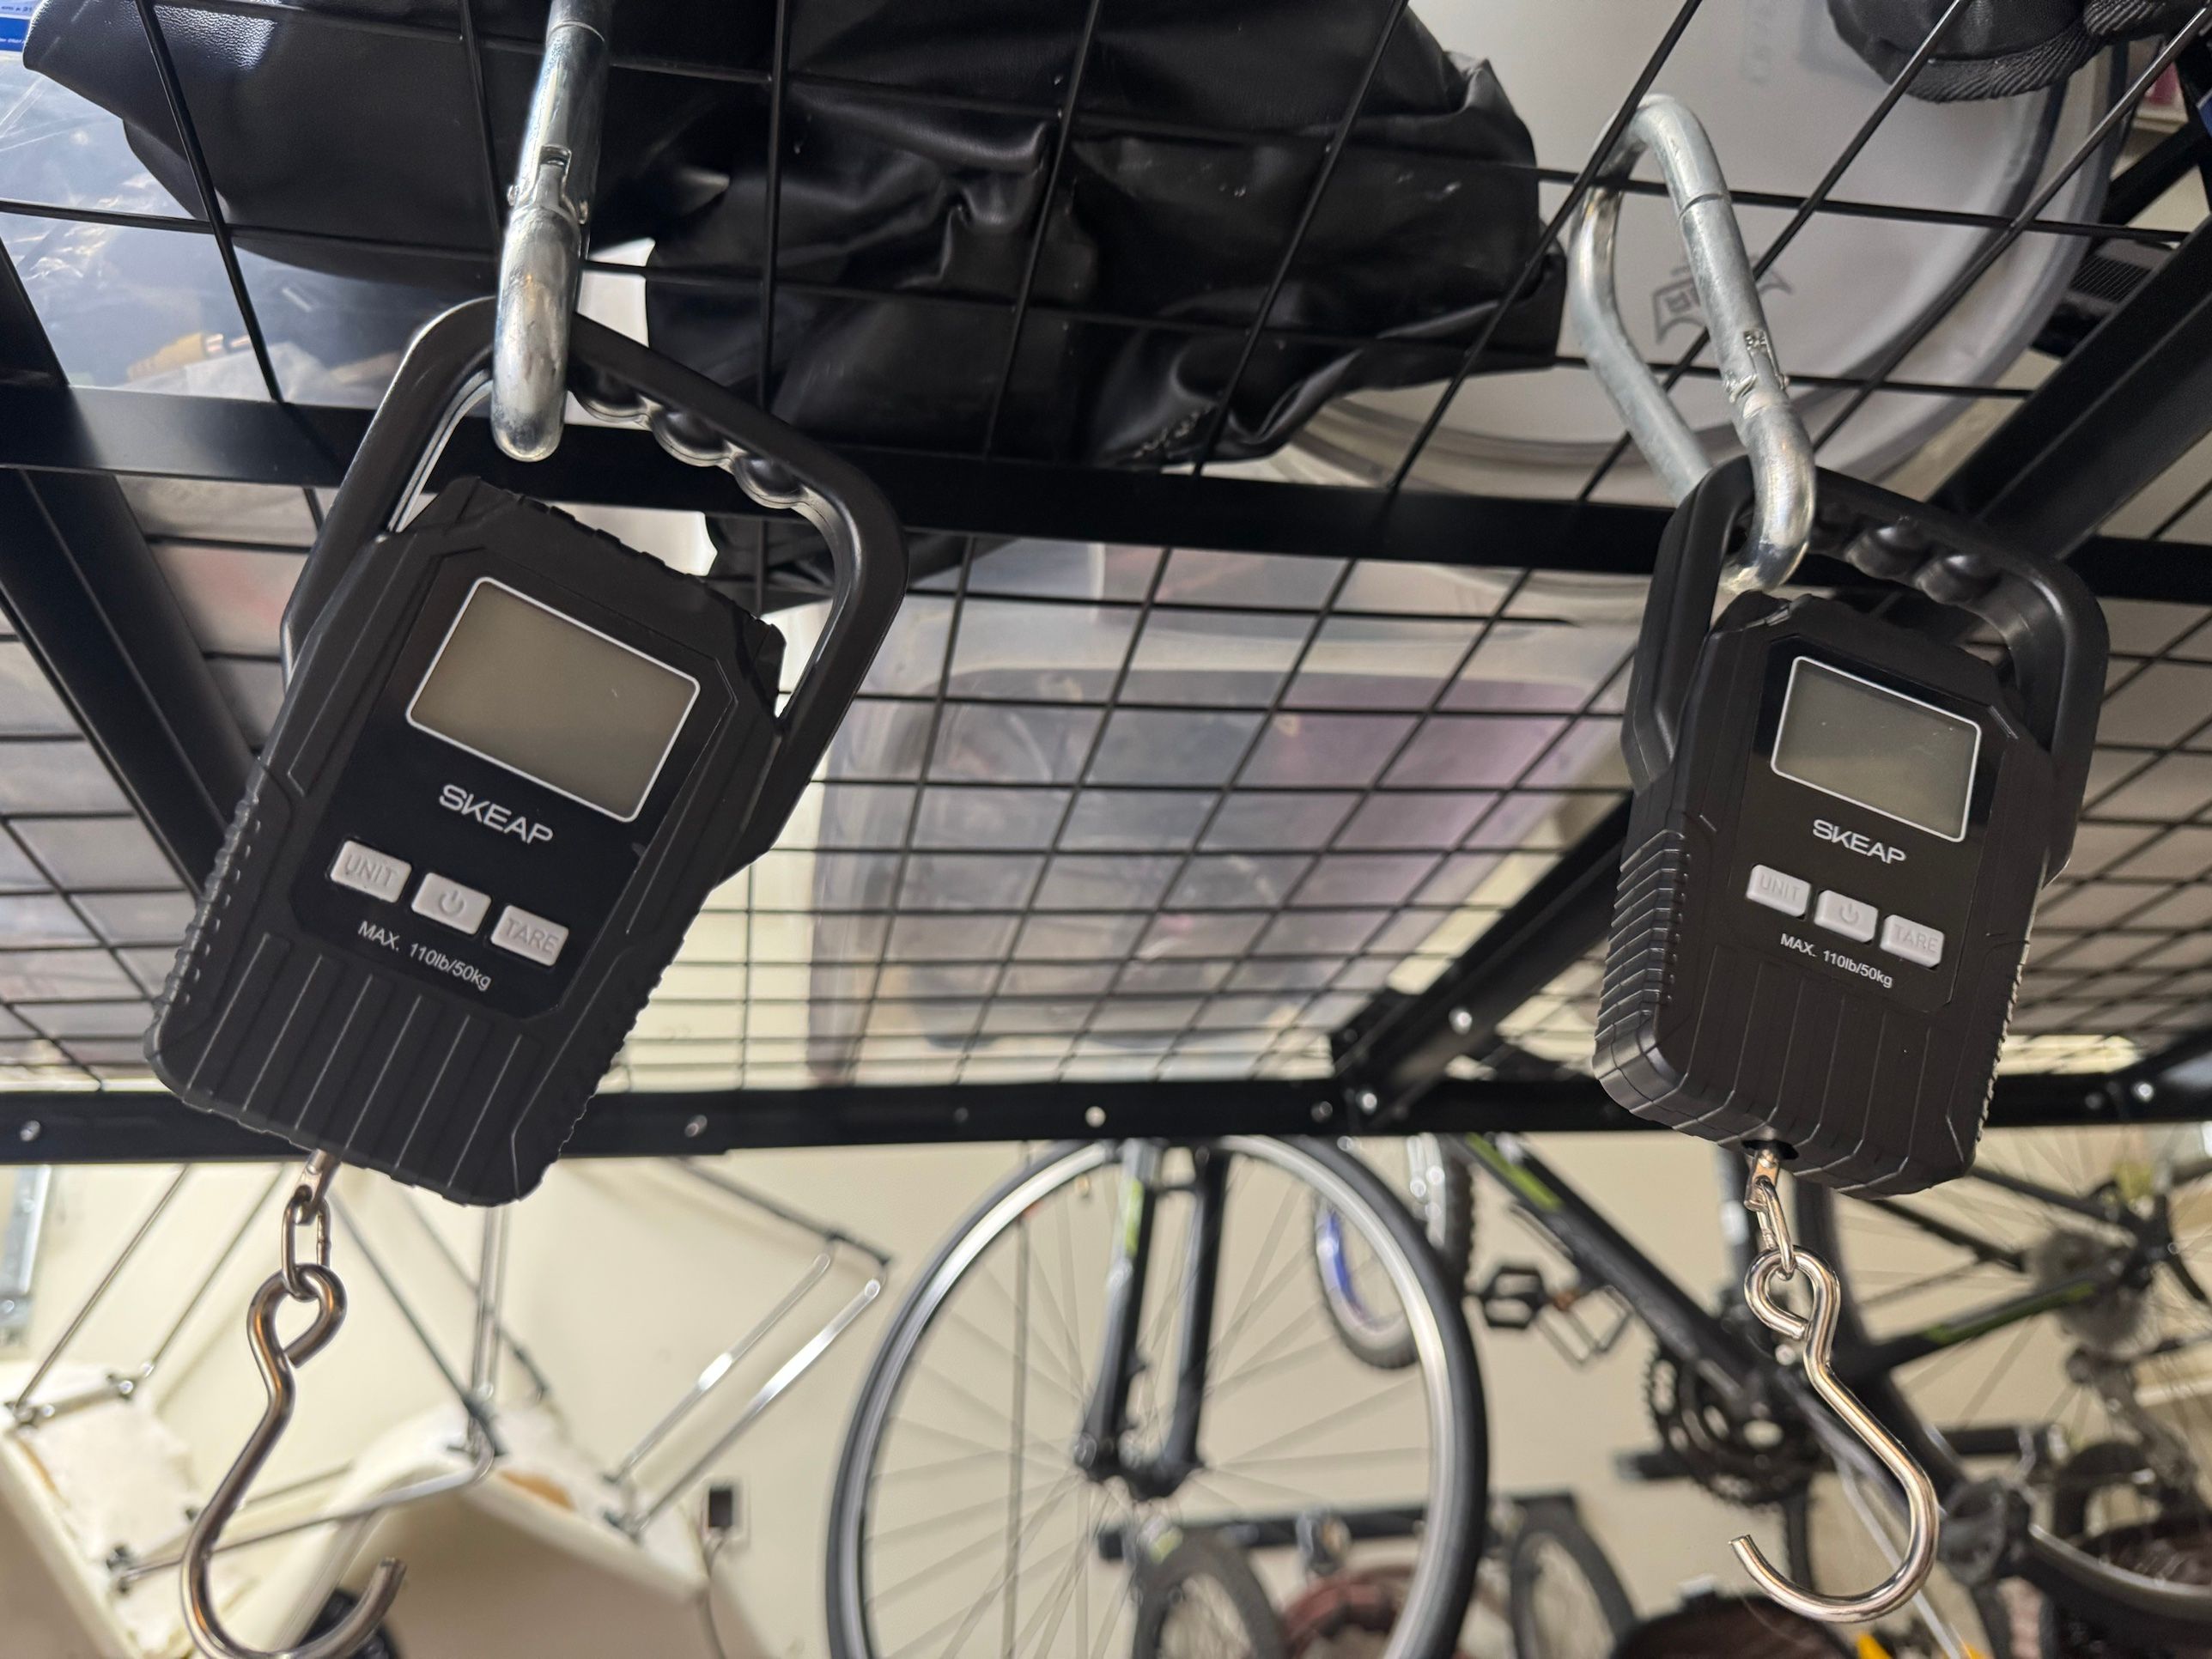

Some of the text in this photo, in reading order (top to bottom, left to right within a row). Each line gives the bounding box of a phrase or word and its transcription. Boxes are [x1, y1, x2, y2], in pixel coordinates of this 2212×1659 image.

[439, 784, 554, 844] SKEAP
[1812, 818, 1907, 864] SKEAP
[344, 854, 398, 888] UNIT
[1759, 874, 1801, 902] UNIT
[358, 921, 492, 991] MAX. 110lb/50kg
[506, 917, 560, 955] TARE
[1893, 923, 1939, 954] TARE
[1780, 933, 1893, 988] MAX. 110lb/50kg
